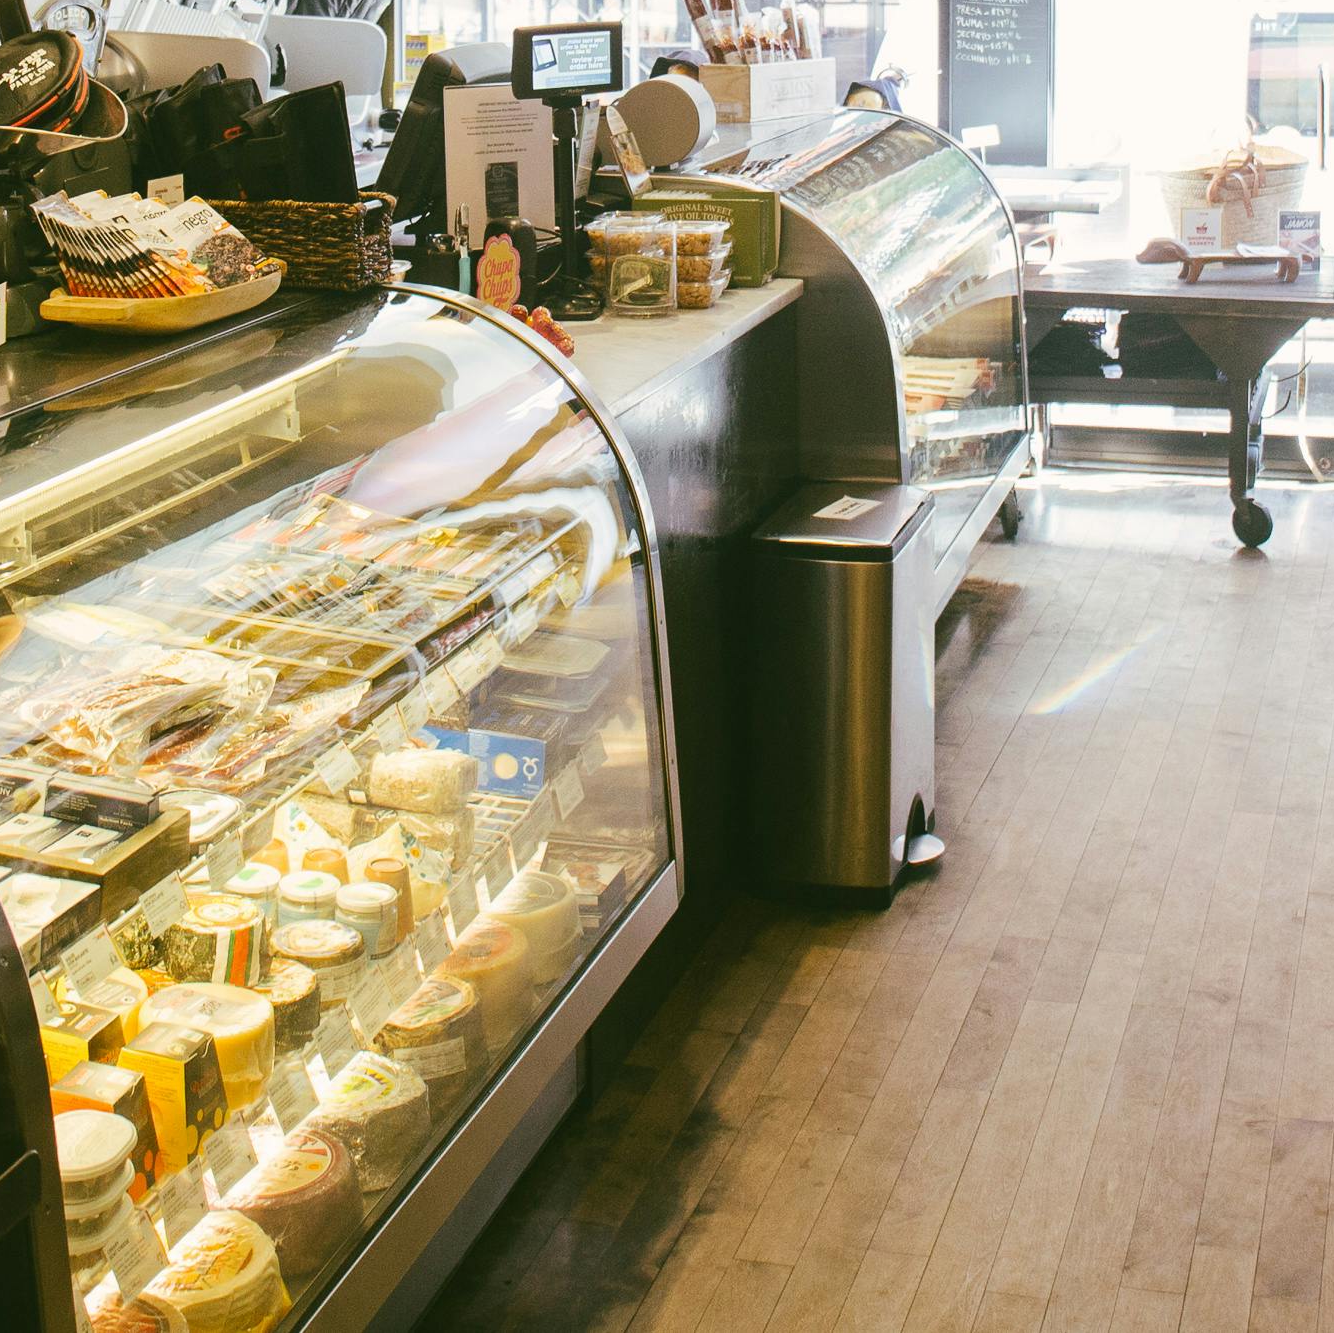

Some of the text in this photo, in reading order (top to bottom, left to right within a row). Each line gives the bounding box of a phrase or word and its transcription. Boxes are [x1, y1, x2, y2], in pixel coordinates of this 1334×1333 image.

[9, 60, 56, 91] PAMPLONA
[182, 208, 214, 231] negro
[659, 204, 733, 217] ORIGINAL SWEET
[686, 212, 700, 221] OIL
[701, 212, 735, 227] TORTAS
[484, 258, 514, 279] Chupa
[482, 276, 513, 300] Chups
